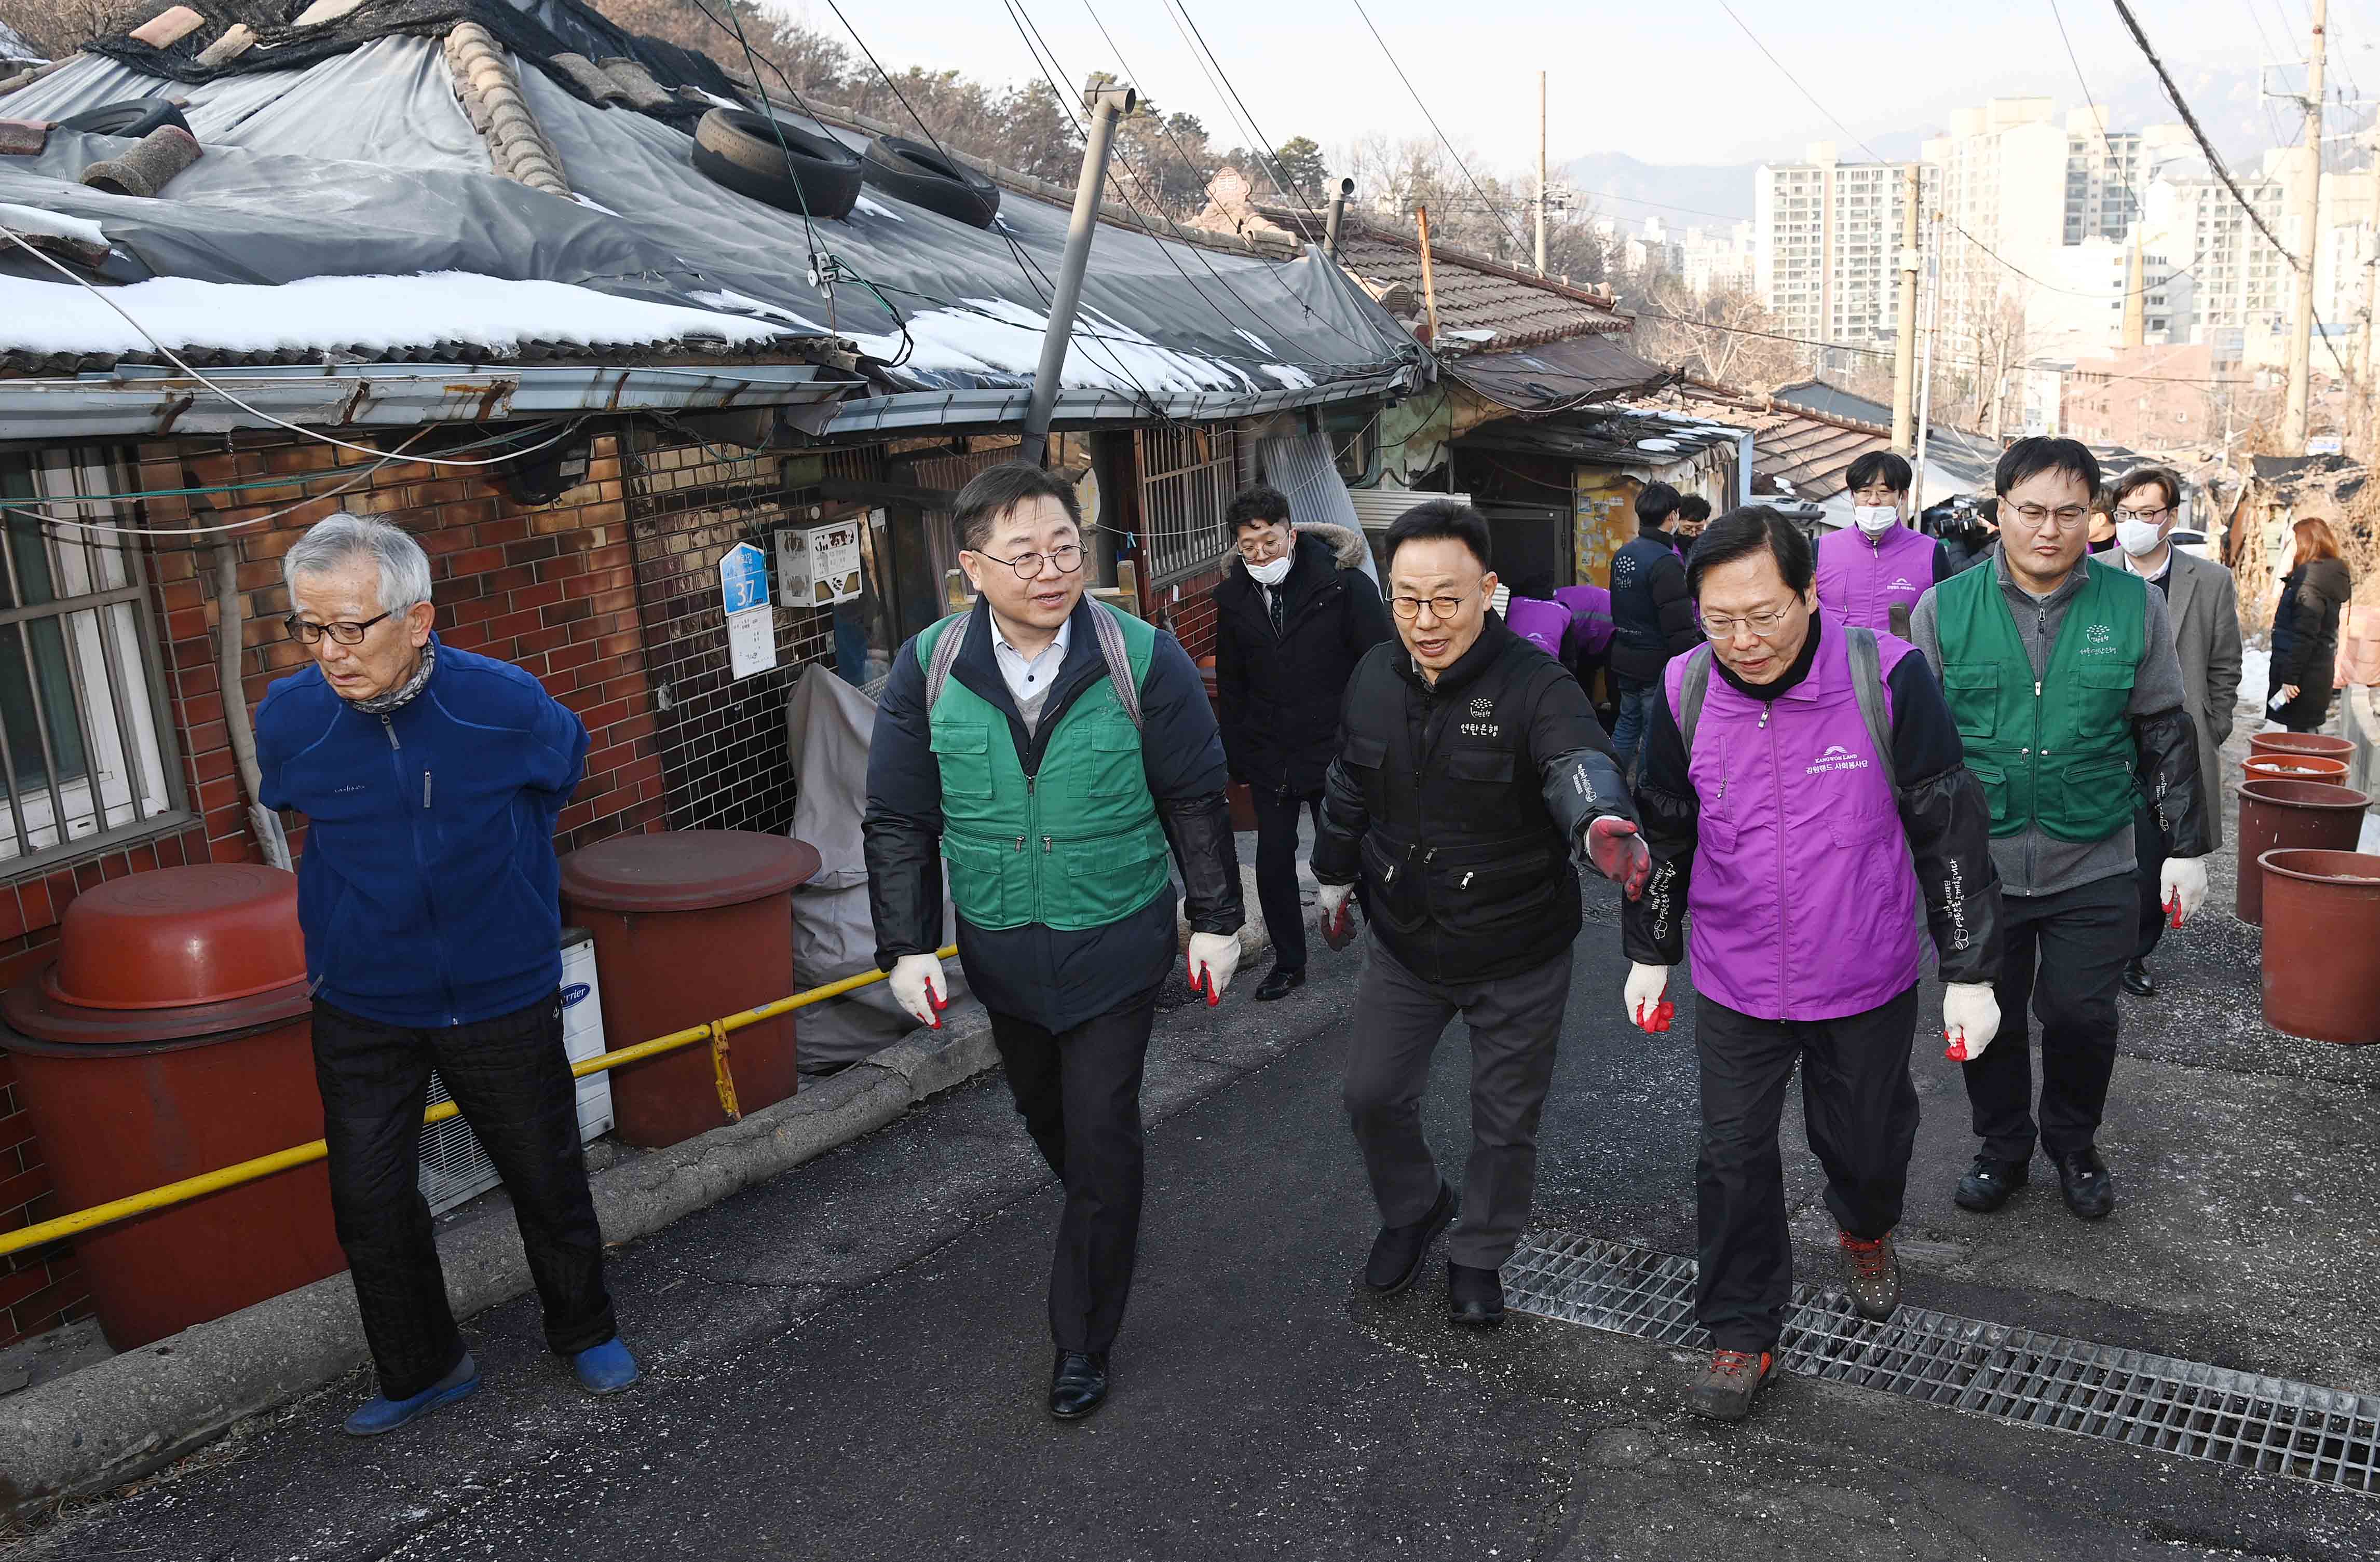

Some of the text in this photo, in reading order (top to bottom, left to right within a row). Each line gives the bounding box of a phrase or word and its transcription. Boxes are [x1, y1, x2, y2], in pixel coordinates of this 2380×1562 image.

[736, 579, 754, 606] 37
[1461, 723, 1499, 737] 연탄은행
[1806, 760, 1869, 774] 강원랜드 사회봉사단
[564, 988, 586, 1001] rrier
